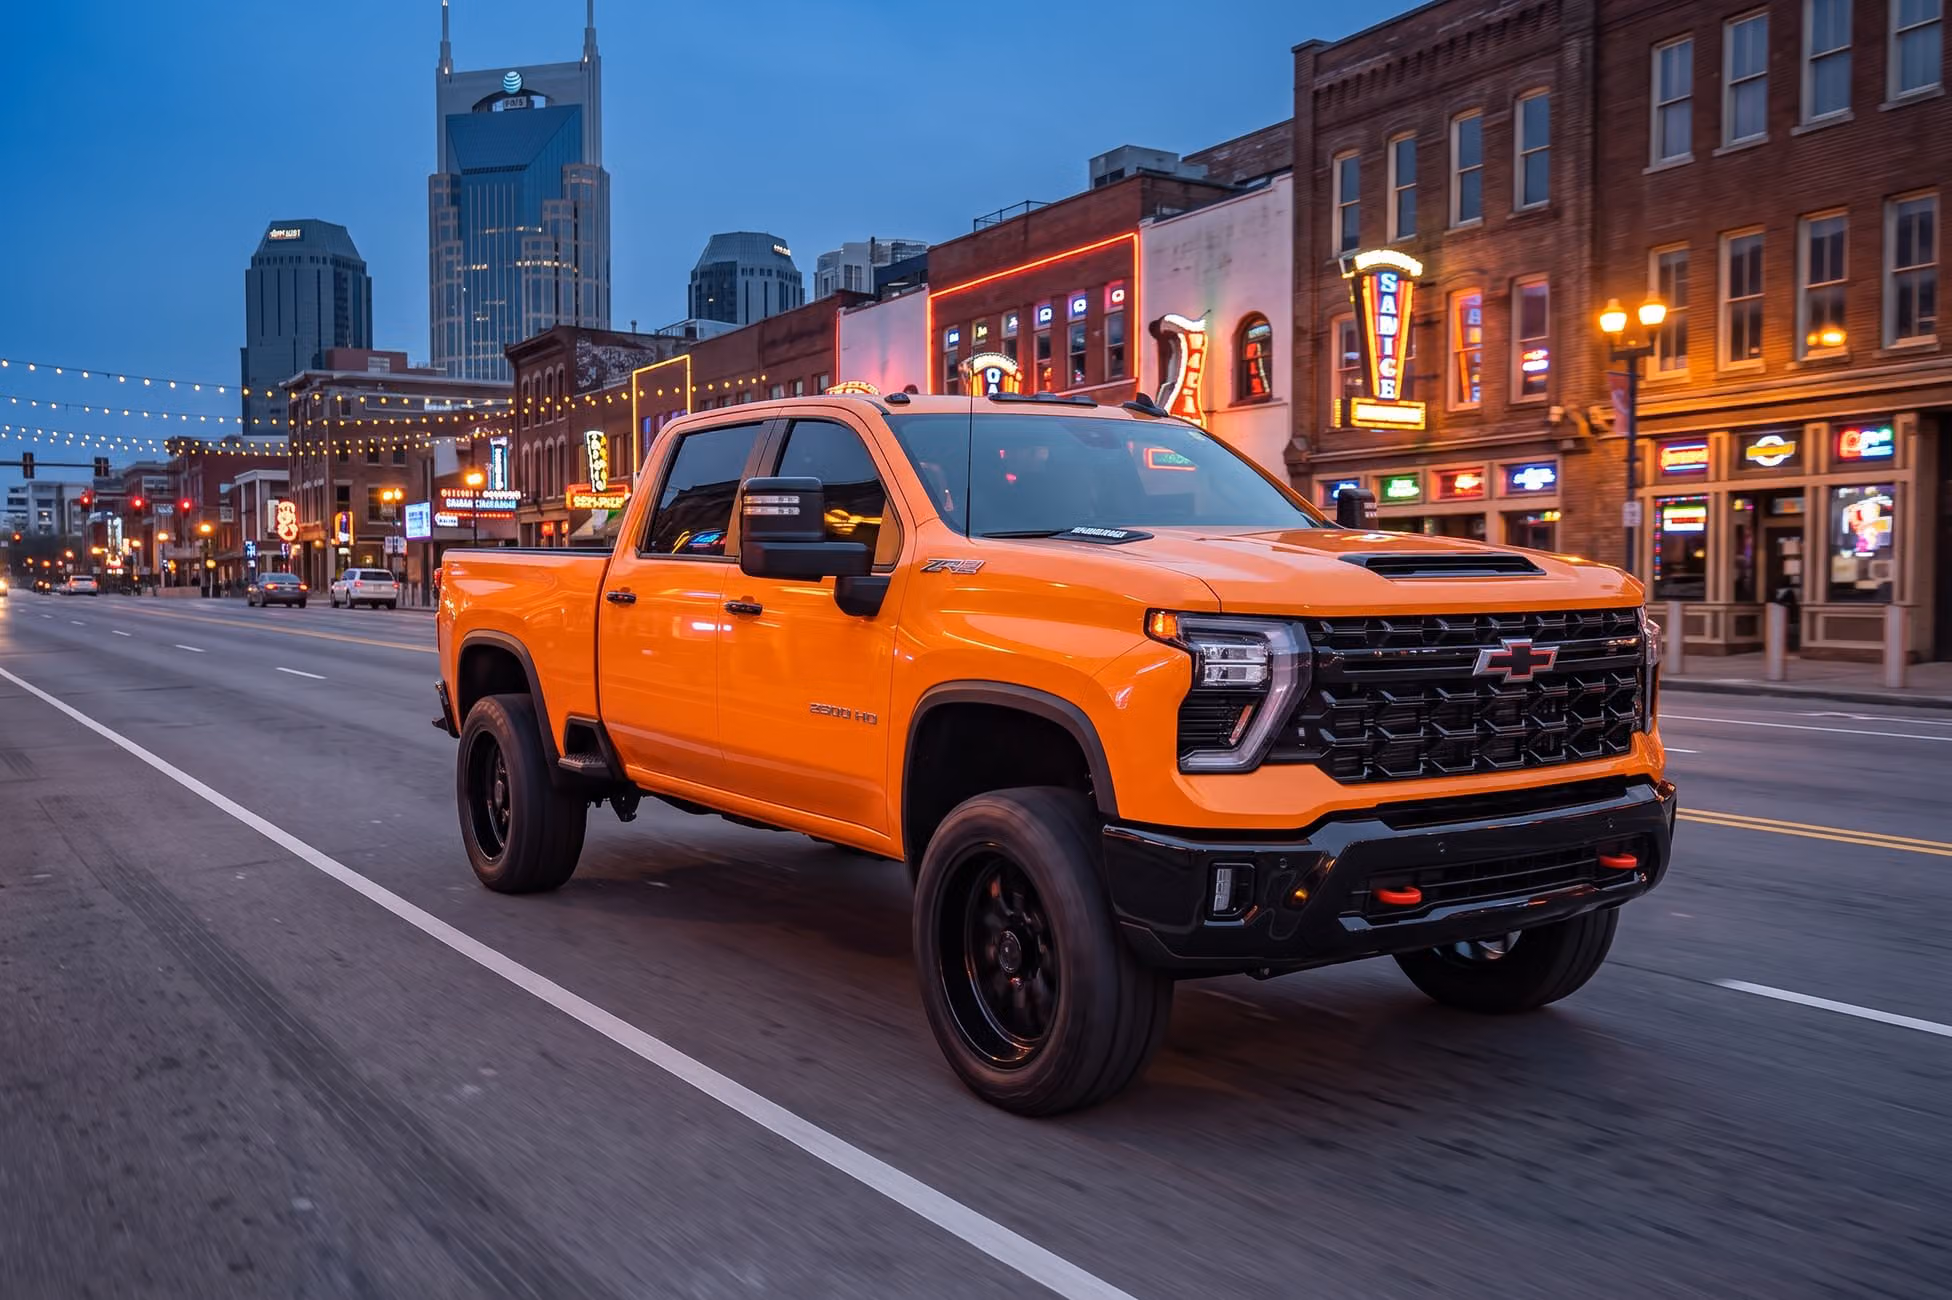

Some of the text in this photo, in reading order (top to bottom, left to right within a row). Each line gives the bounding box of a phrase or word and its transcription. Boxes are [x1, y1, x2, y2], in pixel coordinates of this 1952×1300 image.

[920, 559, 985, 574] ZR2
[810, 703, 878, 725] 2500 HD
